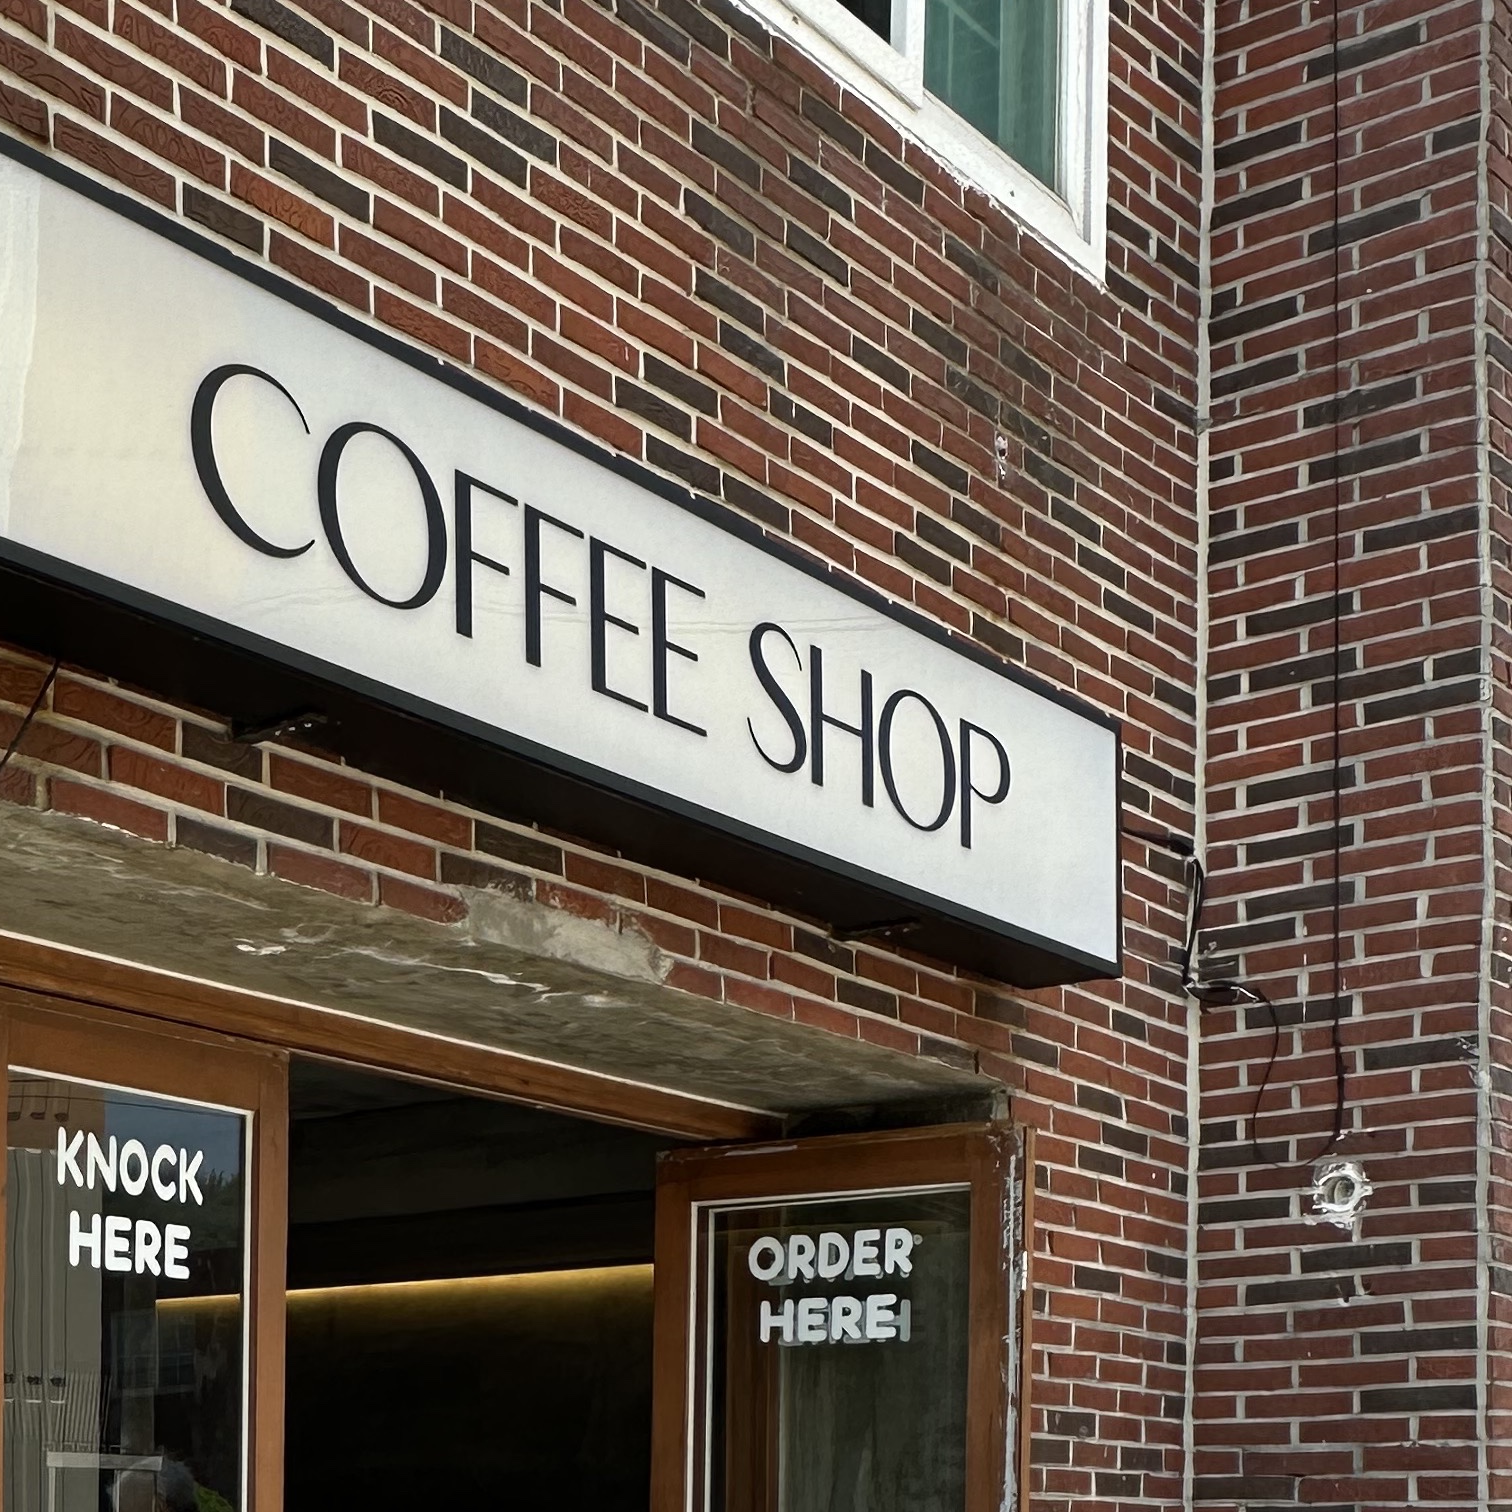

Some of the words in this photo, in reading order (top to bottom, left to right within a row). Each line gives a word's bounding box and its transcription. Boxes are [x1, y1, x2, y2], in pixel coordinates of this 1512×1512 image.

[189, 363, 708, 738] COFFEE
[747, 622, 1011, 850] SHOP
[57, 1126, 204, 1206] KNOCK
[69, 1210, 191, 1280] HERE
[748, 1227, 914, 1282] ORDER
[759, 1293, 898, 1343] HERE
